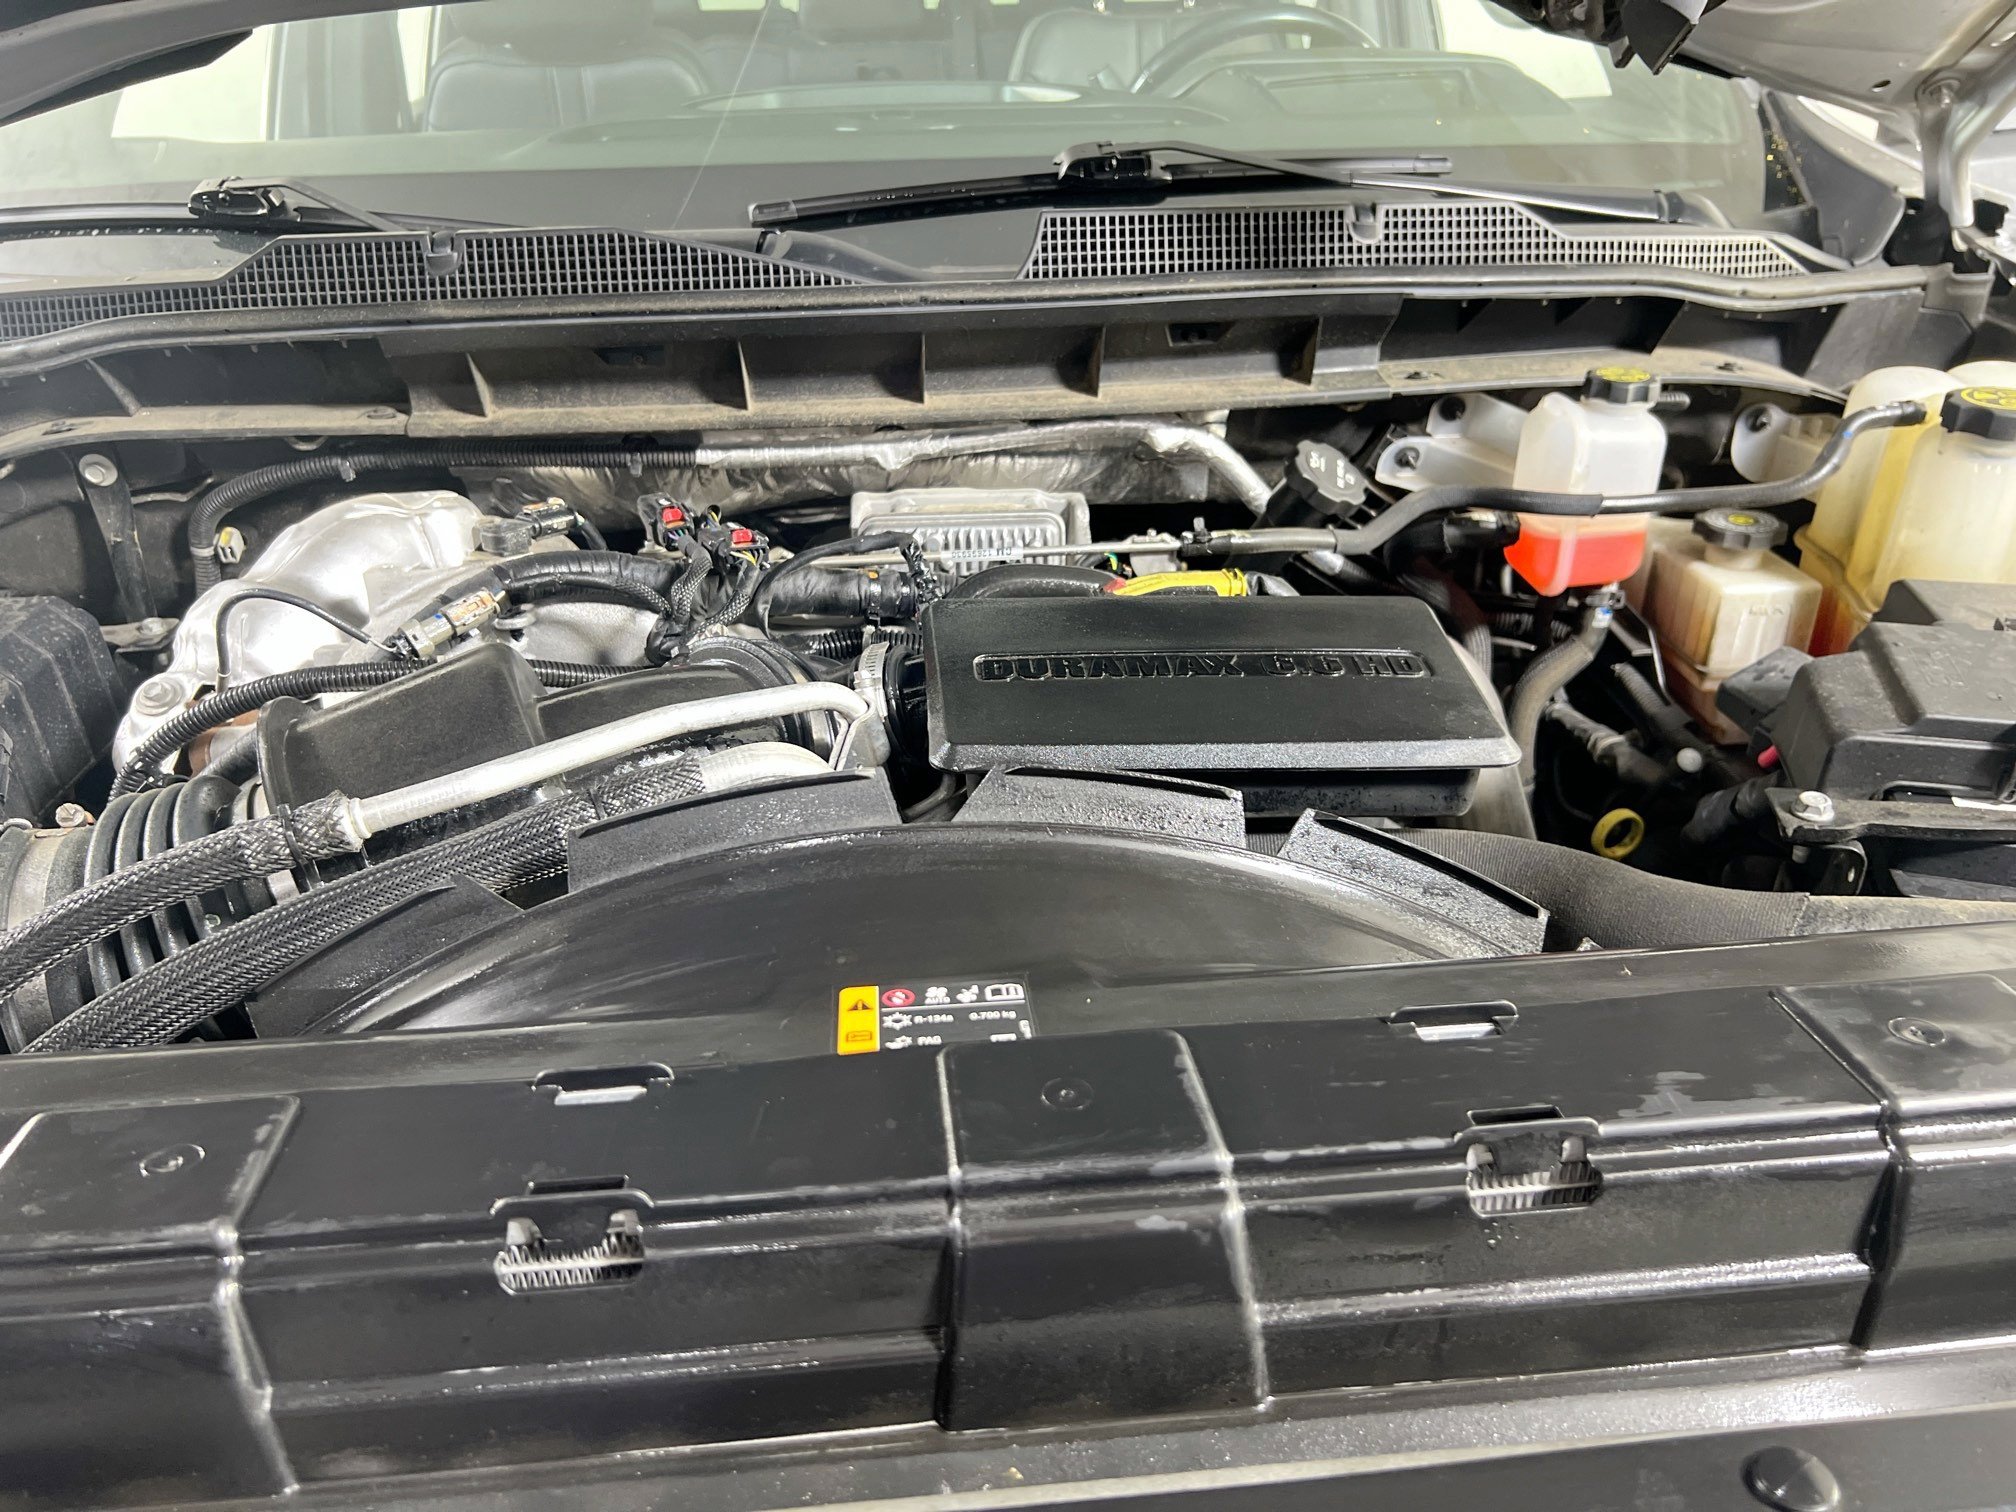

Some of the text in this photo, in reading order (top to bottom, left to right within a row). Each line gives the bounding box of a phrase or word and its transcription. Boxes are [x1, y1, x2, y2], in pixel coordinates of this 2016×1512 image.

[980, 654, 1425, 681] DURAMAX 6.6 HD
[925, 996, 951, 1005] AUTO
